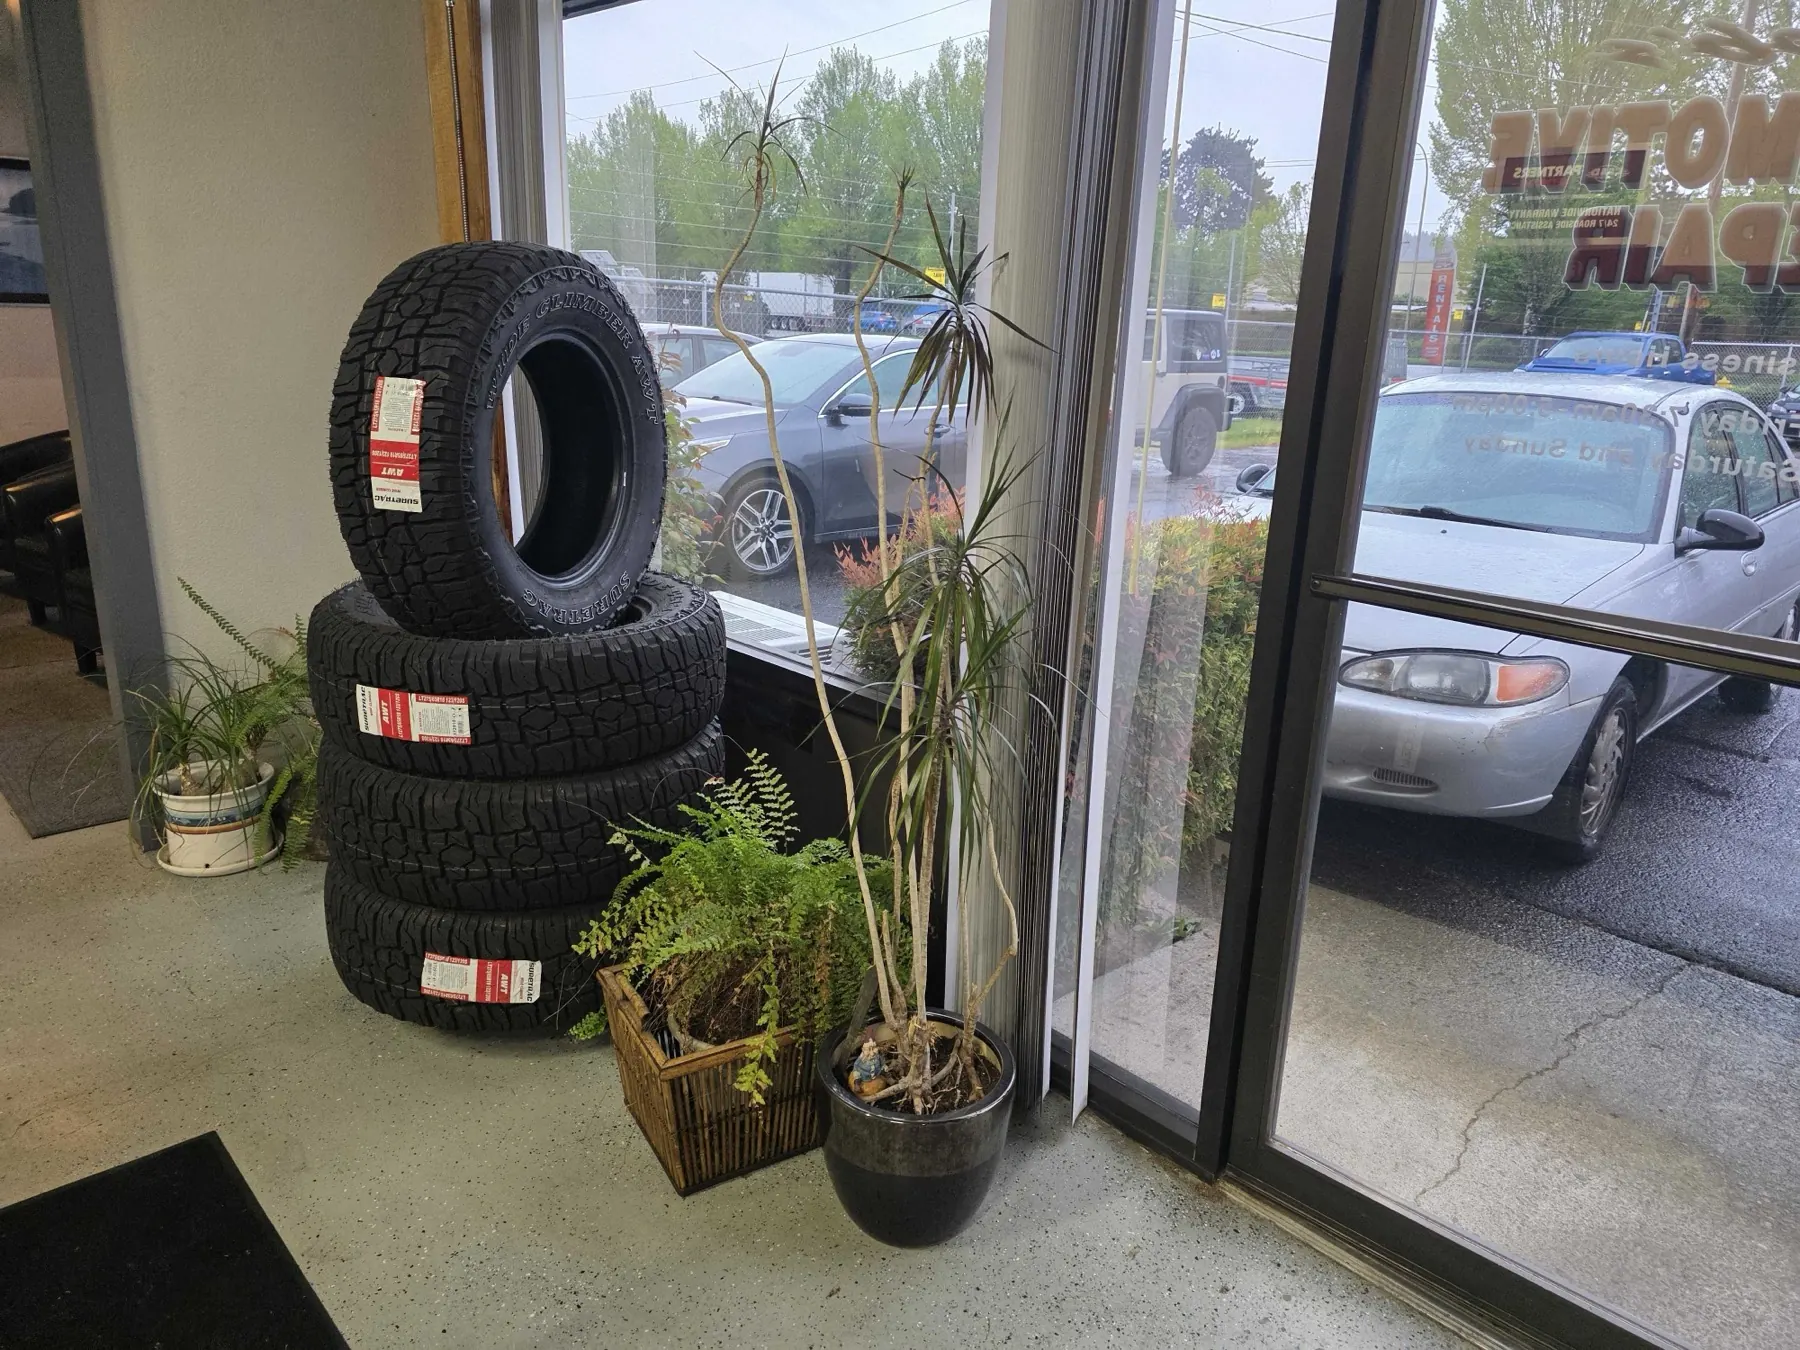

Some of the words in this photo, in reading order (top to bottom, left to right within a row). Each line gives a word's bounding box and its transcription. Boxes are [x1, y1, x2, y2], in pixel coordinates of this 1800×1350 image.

[1427, 273, 1448, 343] RENTALS
[536, 291, 633, 350] CLIMBER
[630, 352, 659, 426] AWT
[381, 466, 404, 477] AWT
[374, 494, 419, 505] SURETRAC
[522, 571, 632, 625] SURETRAC
[361, 686, 370, 732] SURETRAC
[381, 699, 390, 725] AWT
[500, 973, 508, 994] AWT
[527, 961, 535, 1002] SURETRAC
